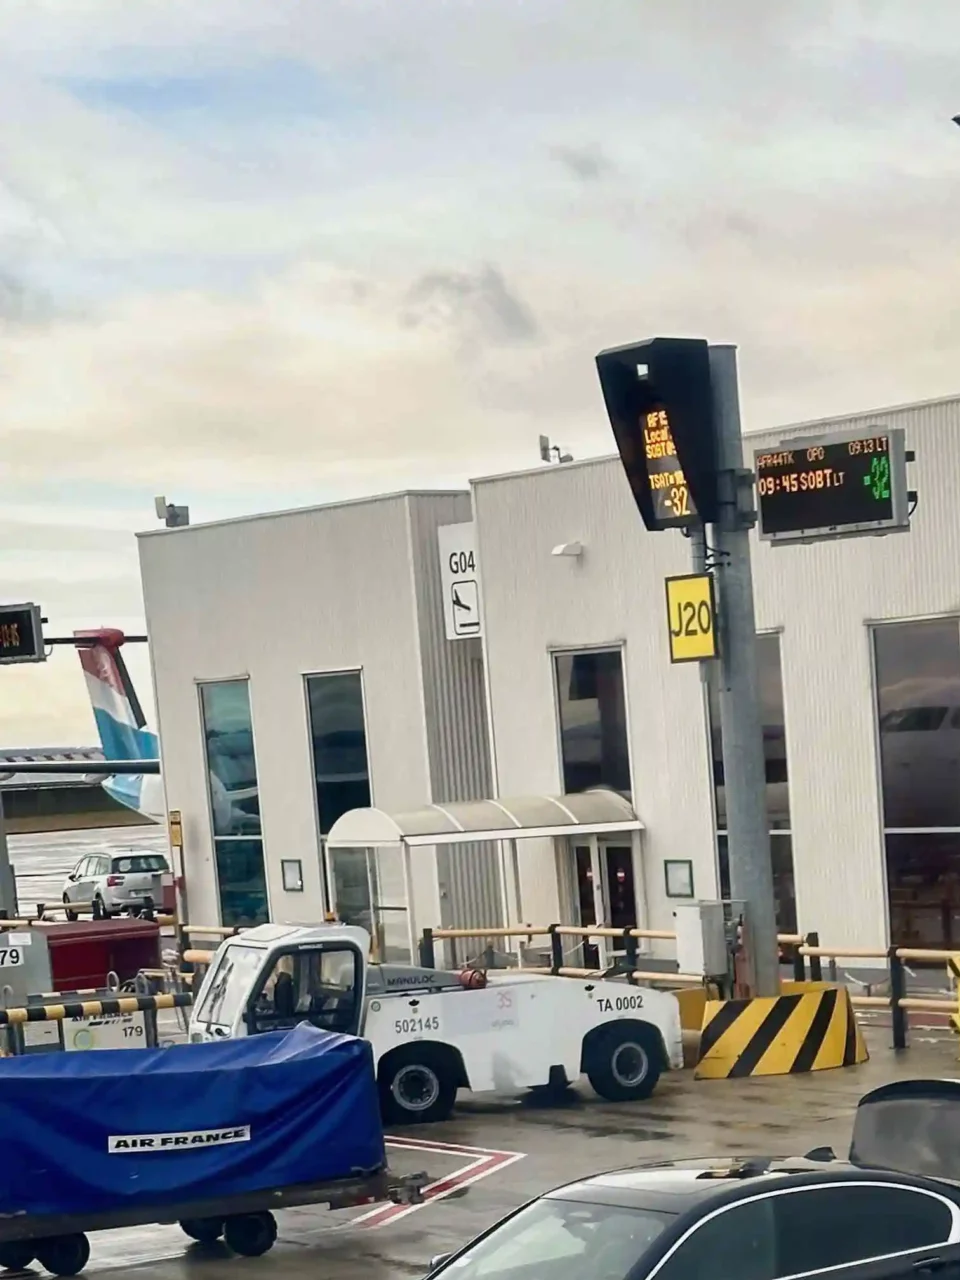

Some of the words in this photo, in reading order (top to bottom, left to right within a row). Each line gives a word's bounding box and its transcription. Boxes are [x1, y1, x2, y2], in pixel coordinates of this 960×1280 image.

[848, 440, 874, 455] 09:13
[876, 437, 888, 451] LT
[758, 473, 798, 496] 09:45
[800, 468, 832, 490] SOBT
[834, 472, 845, 486] LT
[664, 486, 691, 516] -32
[449, 550, 475, 574] G04
[671, 600, 711, 637] J20
[387, 974, 436, 987] MANULOC
[597, 998, 614, 1012] TA
[616, 995, 644, 1011] 0002
[123, 1025, 143, 1038] 179
[395, 1016, 439, 1034] 502145
[114, 1138, 154, 1149] AIR
[161, 1128, 245, 1146] FRANCE
